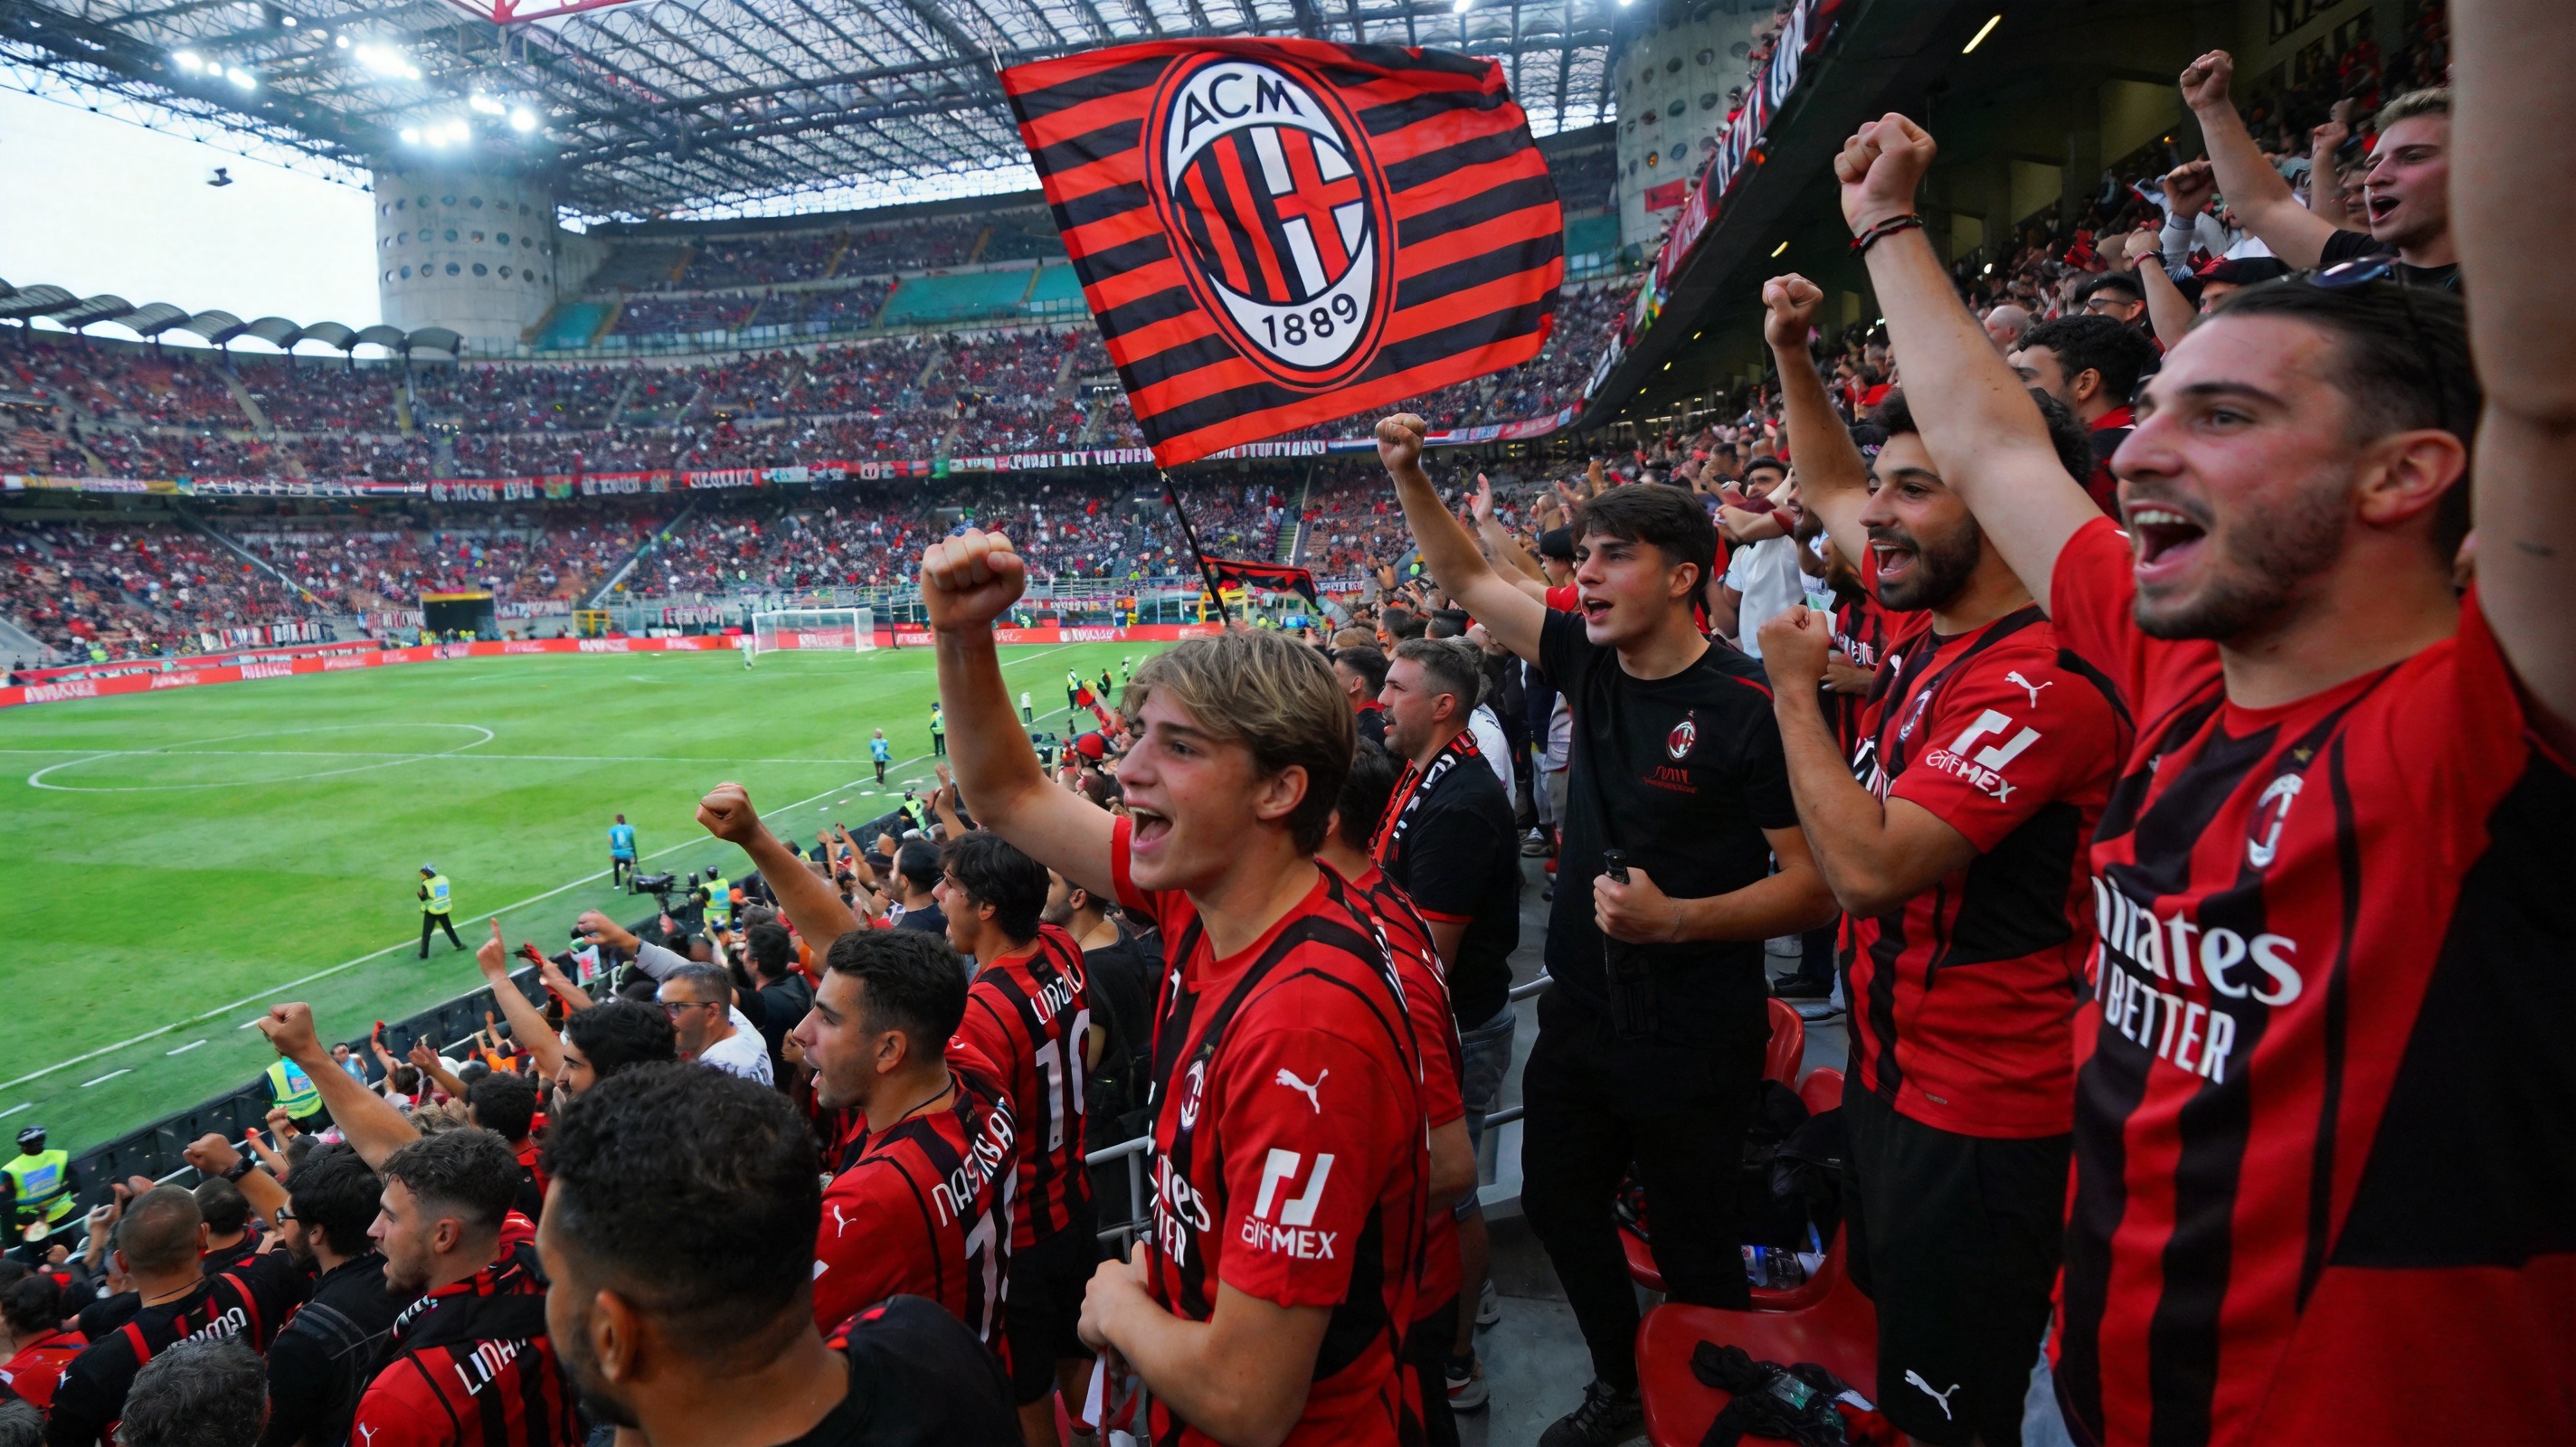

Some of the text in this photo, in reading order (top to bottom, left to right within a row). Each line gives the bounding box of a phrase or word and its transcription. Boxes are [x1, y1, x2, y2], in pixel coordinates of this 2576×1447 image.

[1180, 72, 1305, 154] ACM
[1262, 293, 1359, 348] 1889
[2105, 960, 2236, 1084] BETTER
